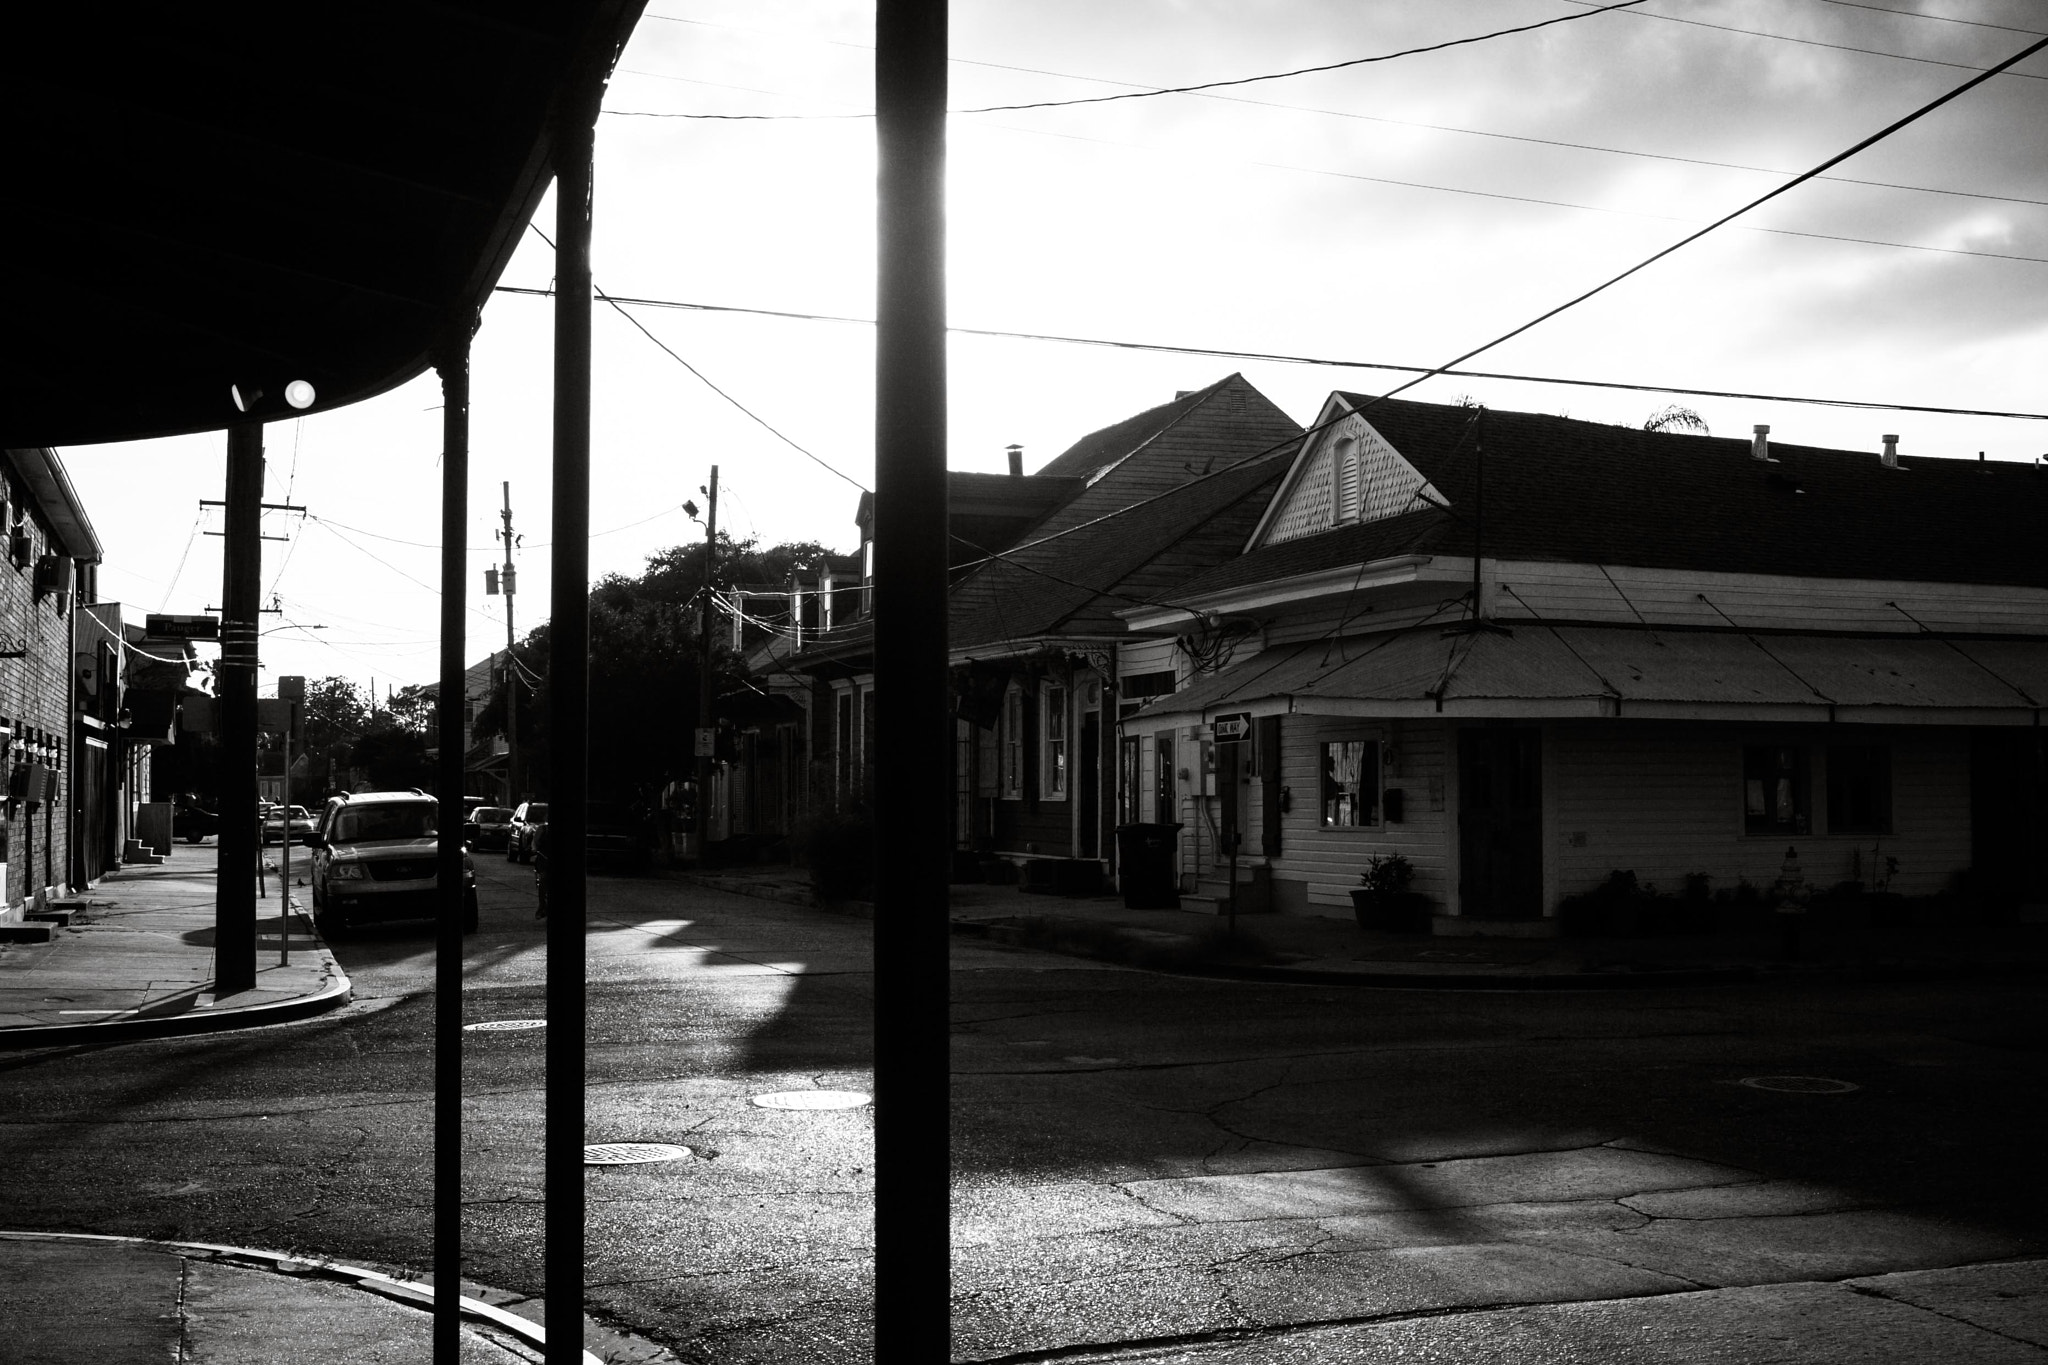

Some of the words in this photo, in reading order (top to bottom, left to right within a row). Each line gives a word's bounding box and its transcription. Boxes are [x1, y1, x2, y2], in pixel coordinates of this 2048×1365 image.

[164, 622, 200, 635] Pauger
[1218, 723, 1228, 734] ONE
[1230, 722, 1240, 733] WAY
